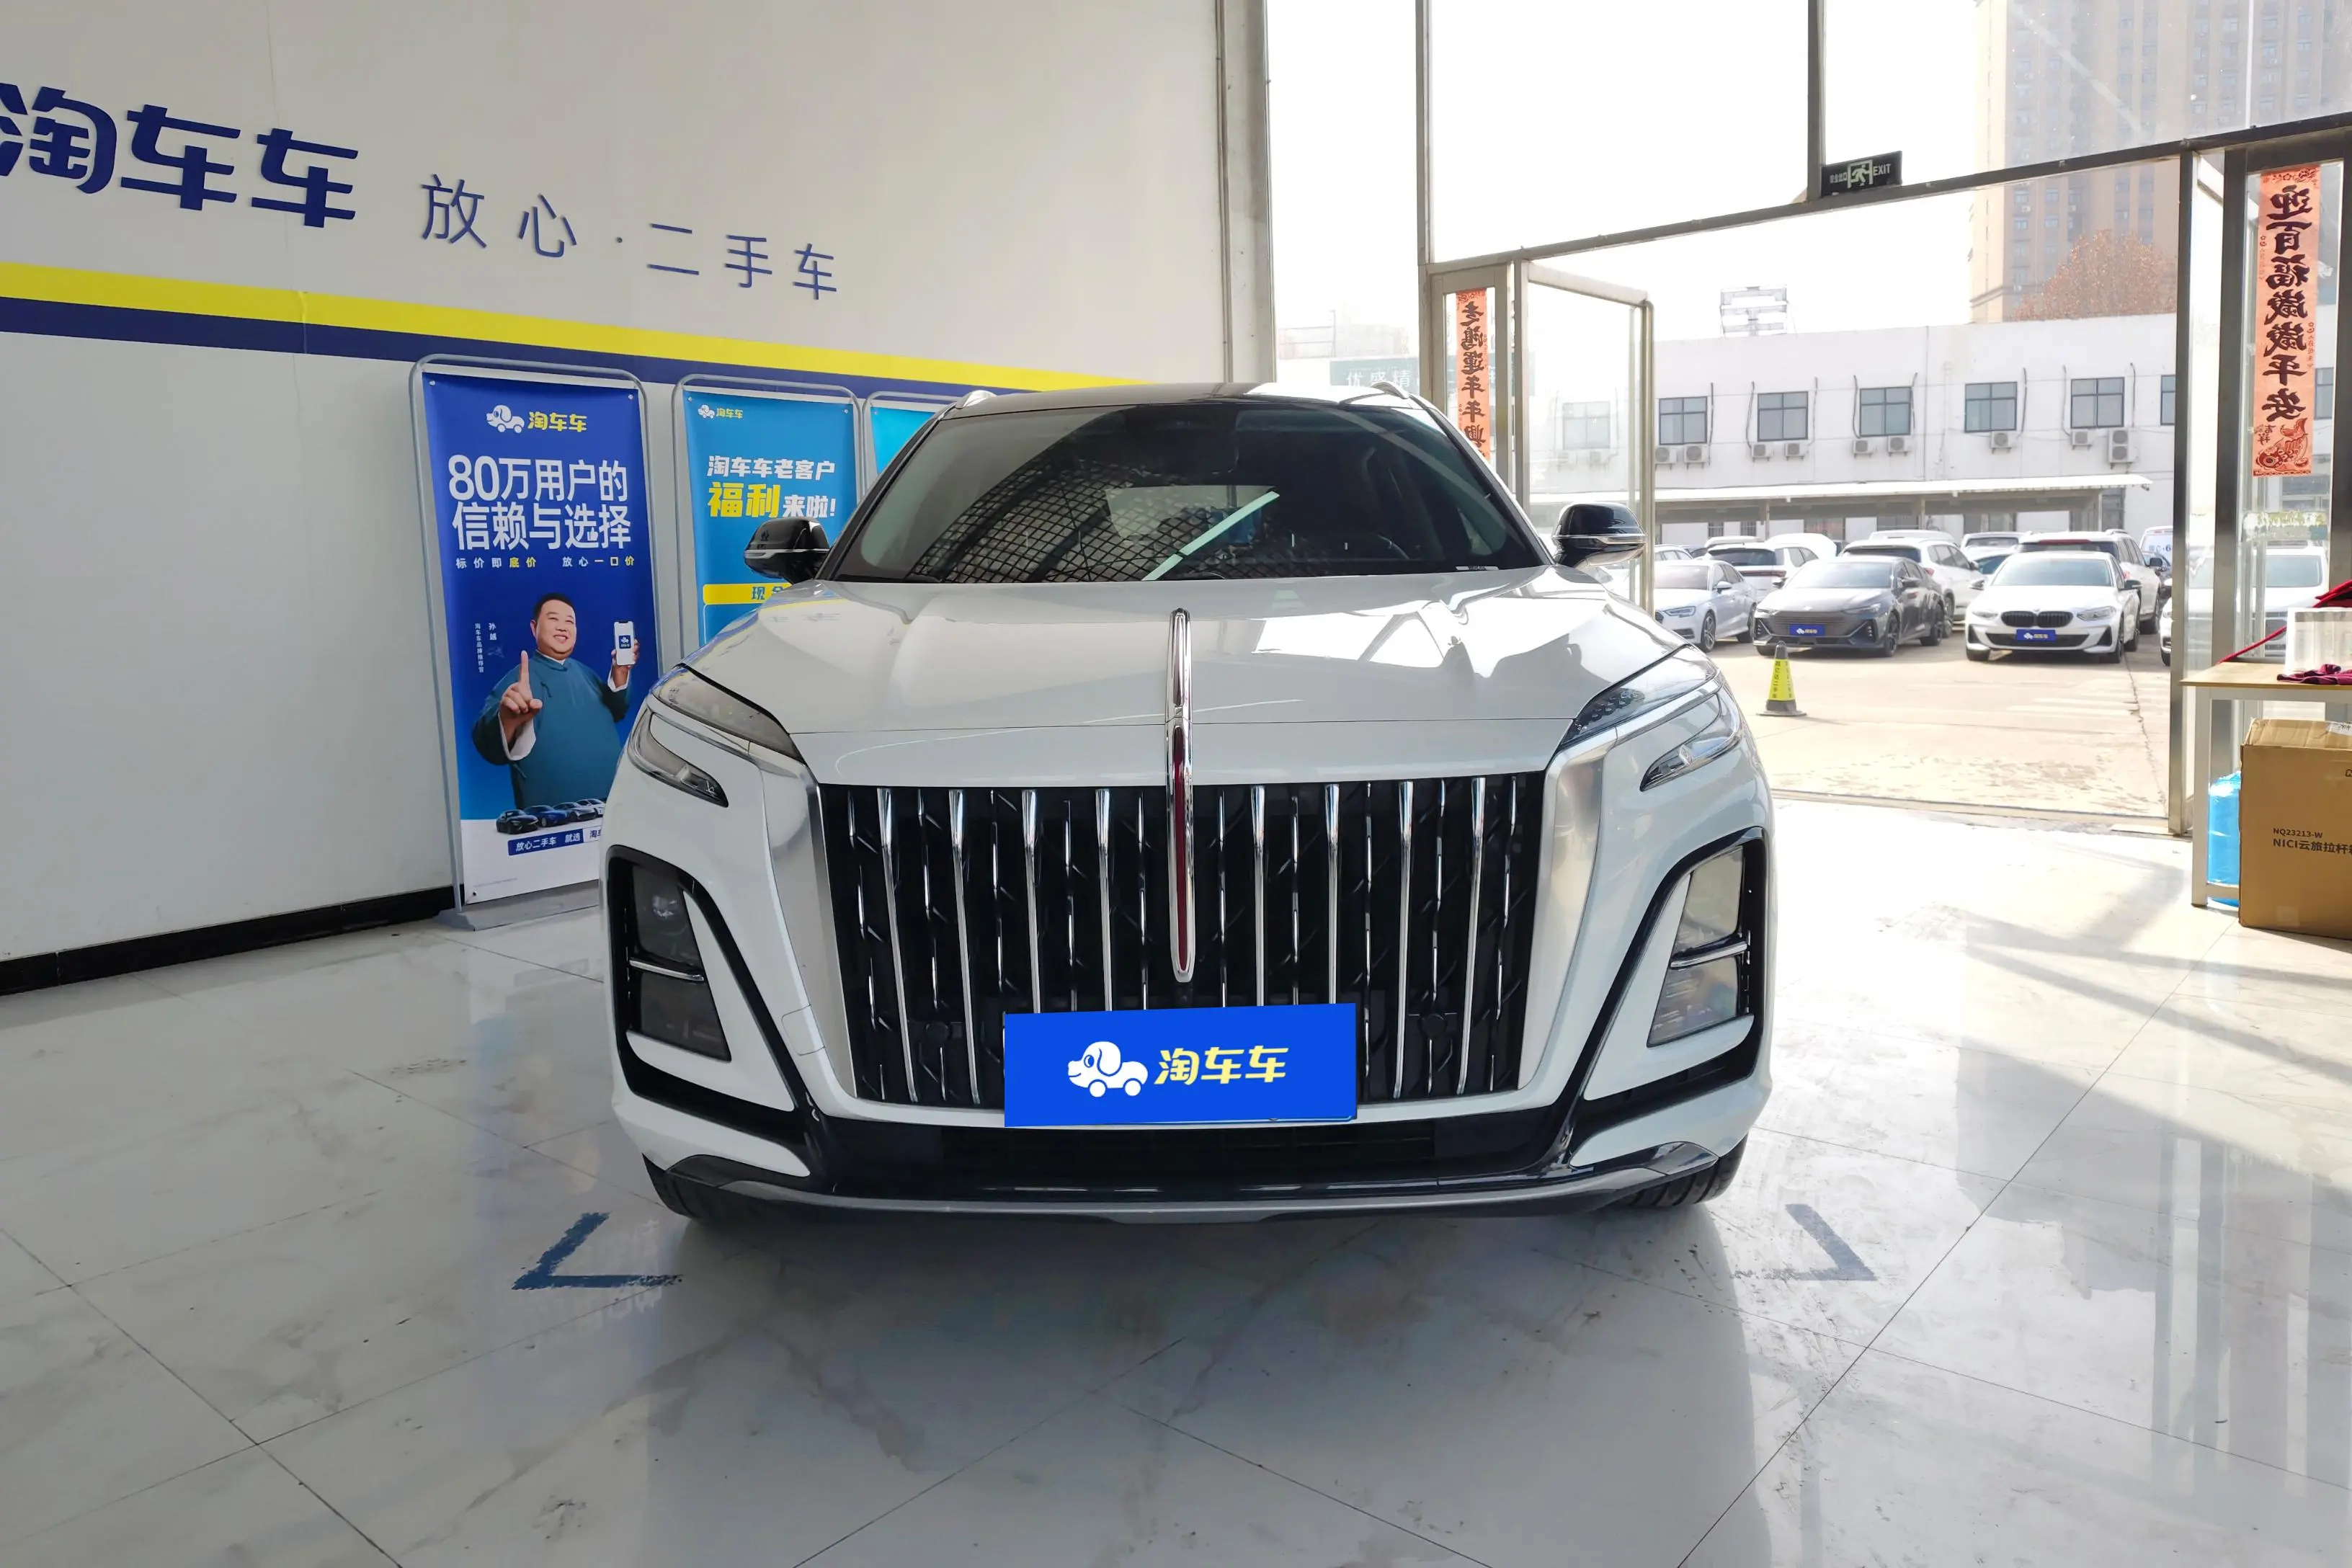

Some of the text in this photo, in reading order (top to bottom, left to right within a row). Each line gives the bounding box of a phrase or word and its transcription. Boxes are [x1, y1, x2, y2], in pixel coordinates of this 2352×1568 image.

[0, 83, 359, 228] 淘车车
[1874, 163, 1892, 176] EXIT
[527, 411, 587, 432] 淘车车
[716, 407, 743, 419] 淘车车
[707, 455, 836, 481] 淘车车老客户
[448, 454, 628, 502] 80万用户的
[451, 500, 631, 551] 信赖与选择
[455, 556, 635, 569] 标价即底价 放心一口价
[2273, 828, 2323, 838] NQ23213-W
[516, 836, 557, 852] 放心二手车
[2273, 838, 2352, 856] NICI云旅拉杆
